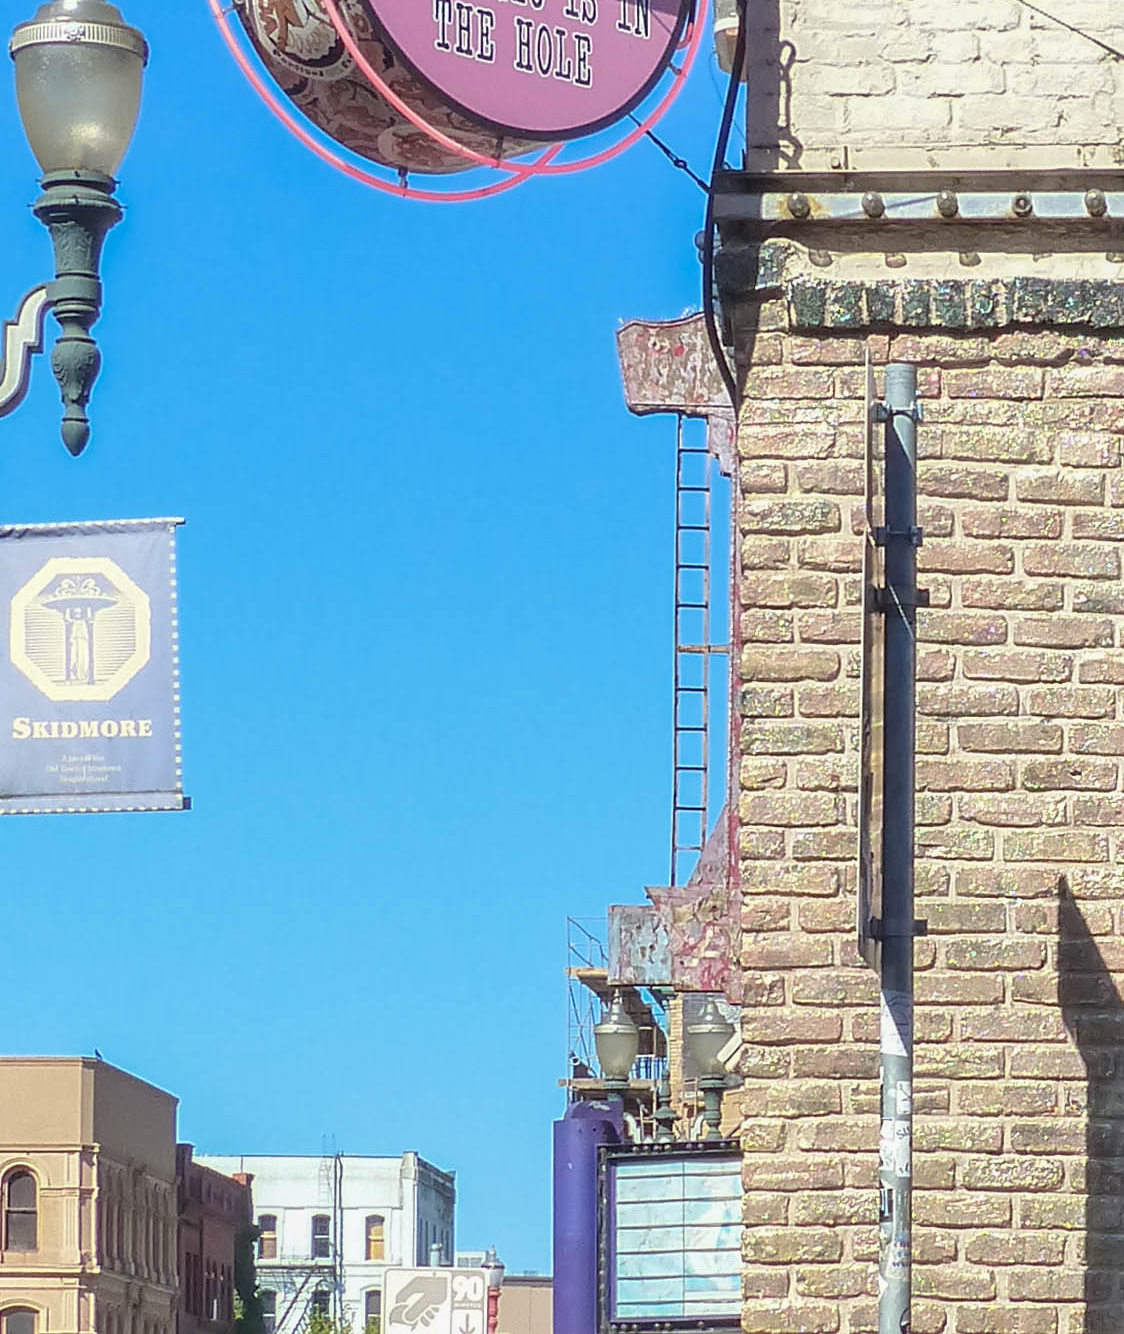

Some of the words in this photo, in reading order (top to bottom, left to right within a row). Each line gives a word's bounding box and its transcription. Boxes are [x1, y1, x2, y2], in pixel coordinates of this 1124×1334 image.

[514, 17, 592, 87] HOLE
[12, 717, 153, 740] SKIDMORE
[452, 1274, 484, 1302] 90
